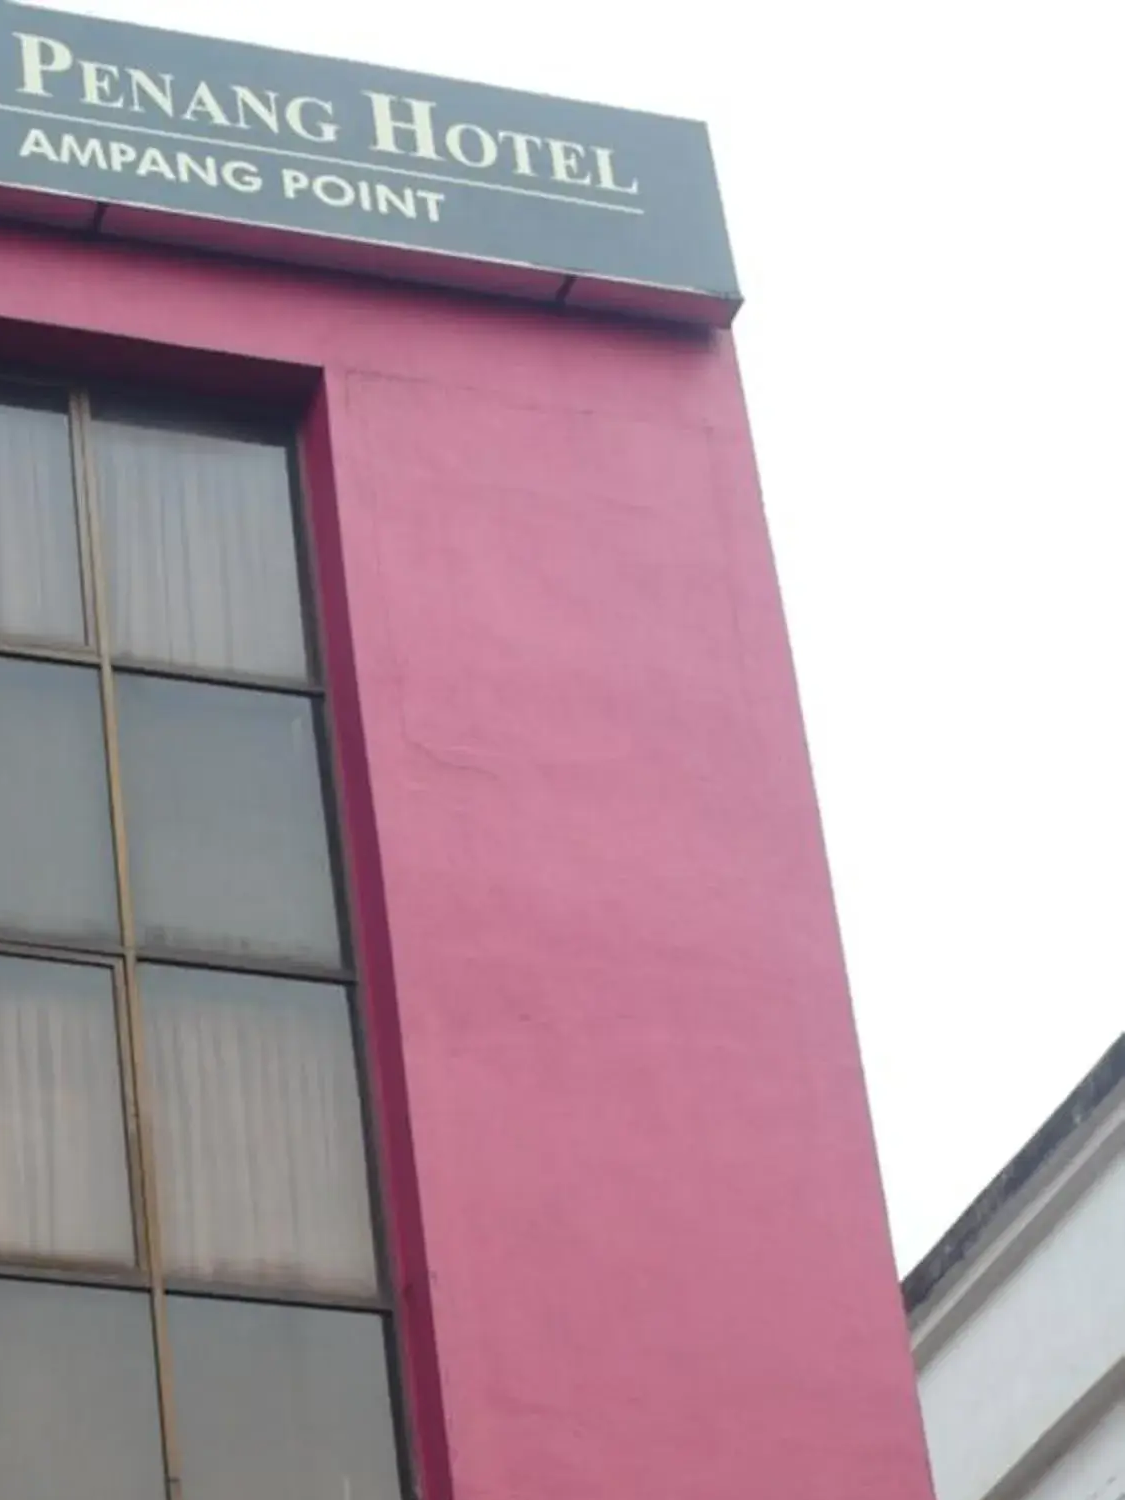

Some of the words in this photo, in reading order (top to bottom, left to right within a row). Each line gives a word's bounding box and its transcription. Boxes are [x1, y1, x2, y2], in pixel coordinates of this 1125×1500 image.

[12, 31, 341, 142] PENANG
[362, 90, 640, 195] HOTEL
[19, 128, 263, 192] AMPANG
[281, 168, 446, 222] POINT
